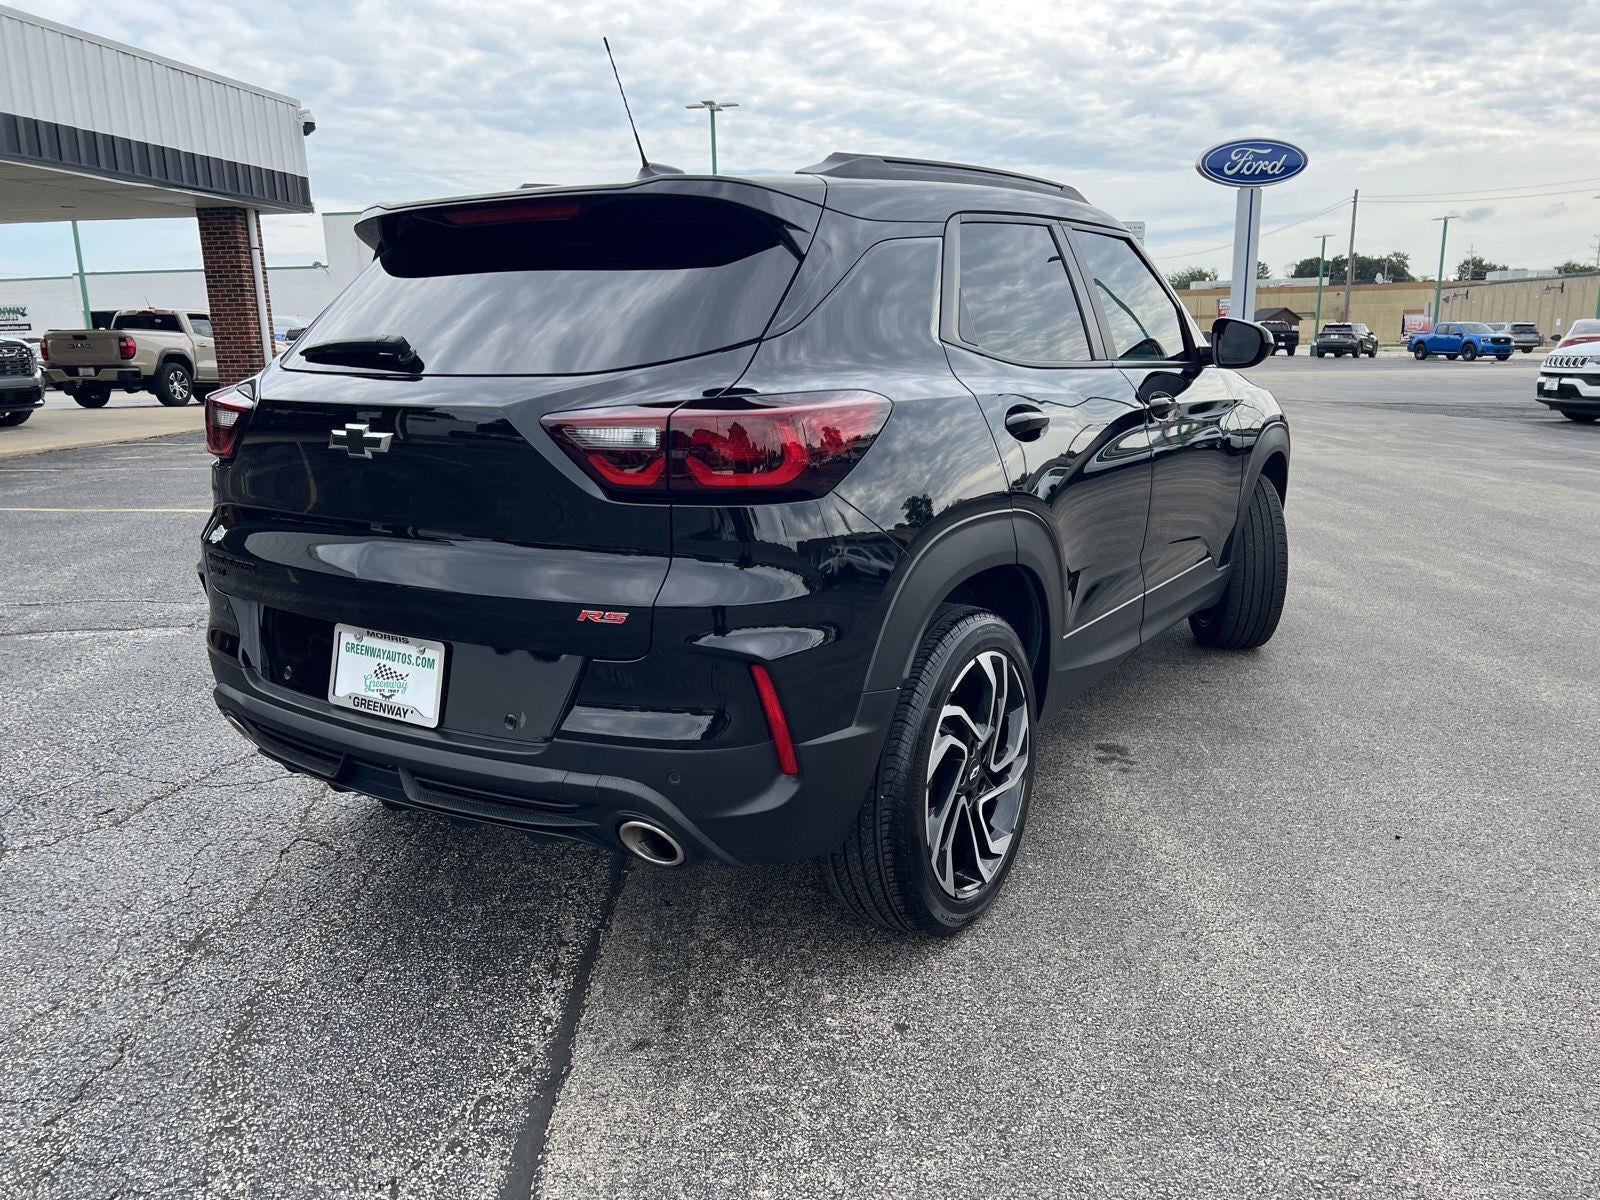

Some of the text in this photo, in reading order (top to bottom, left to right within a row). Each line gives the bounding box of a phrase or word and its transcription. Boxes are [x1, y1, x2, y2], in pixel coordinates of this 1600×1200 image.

[1223, 147, 1288, 175] Ford
[577, 609, 629, 624] RS
[366, 630, 410, 644] MORRIS
[345, 641, 436, 670] GREENWAYAUTOS.COM
[363, 673, 409, 695] Greenway
[352, 696, 409, 719] GREENWAY
